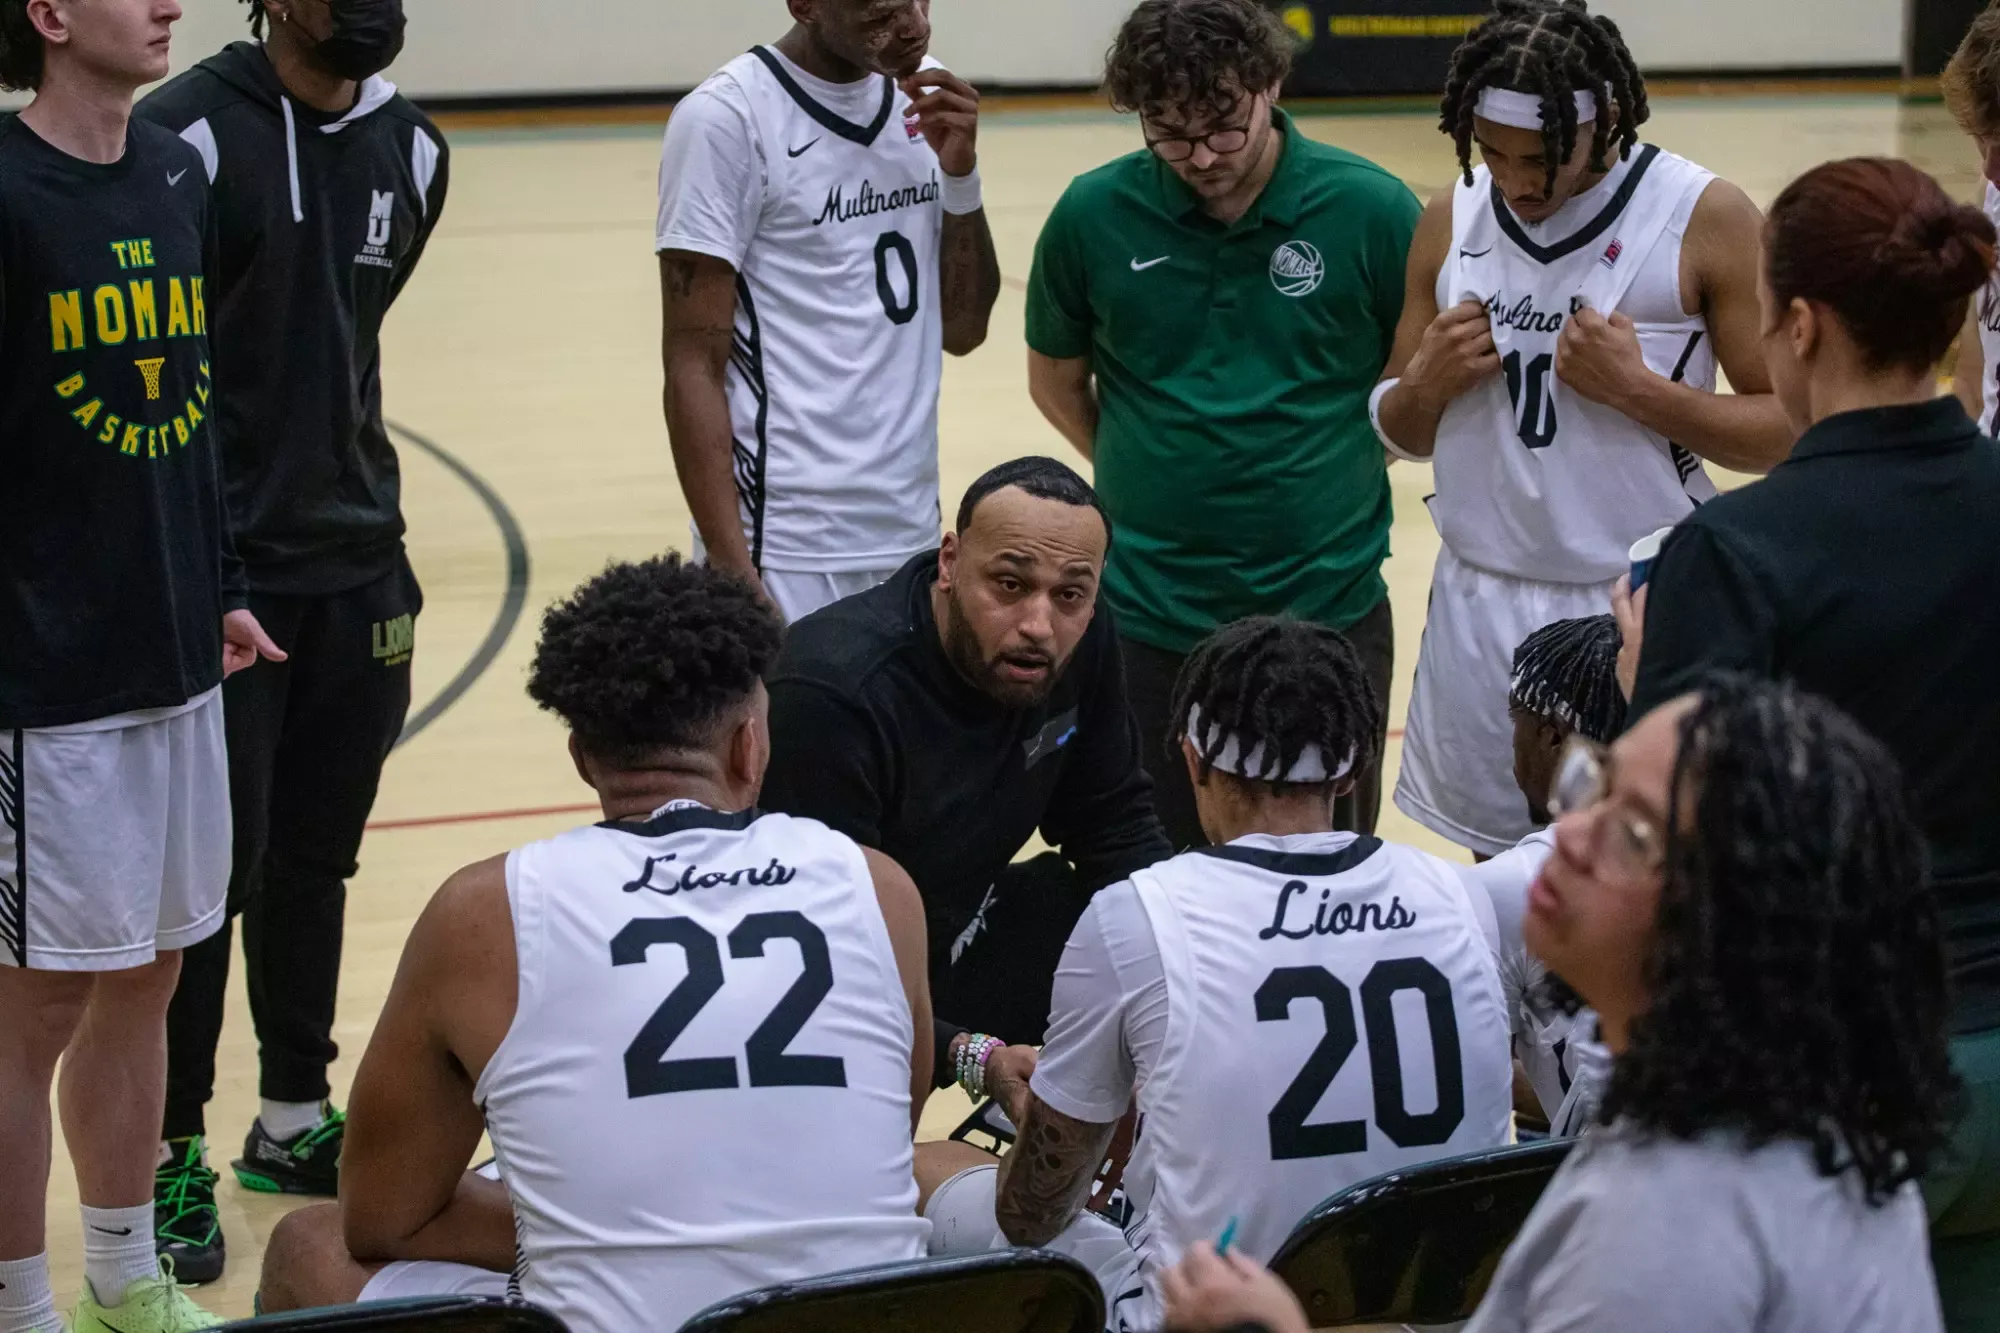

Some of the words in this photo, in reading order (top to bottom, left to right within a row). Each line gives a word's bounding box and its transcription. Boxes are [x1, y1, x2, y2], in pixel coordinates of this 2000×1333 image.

[812, 168, 939, 226] Multnomah
[110, 238, 156, 269] THE
[874, 231, 918, 325] 0
[1502, 349, 1557, 448] 10
[622, 853, 796, 896] Lions
[1258, 880, 1416, 940] Lions
[609, 911, 848, 1099] 22
[1254, 956, 1465, 1161] 20
